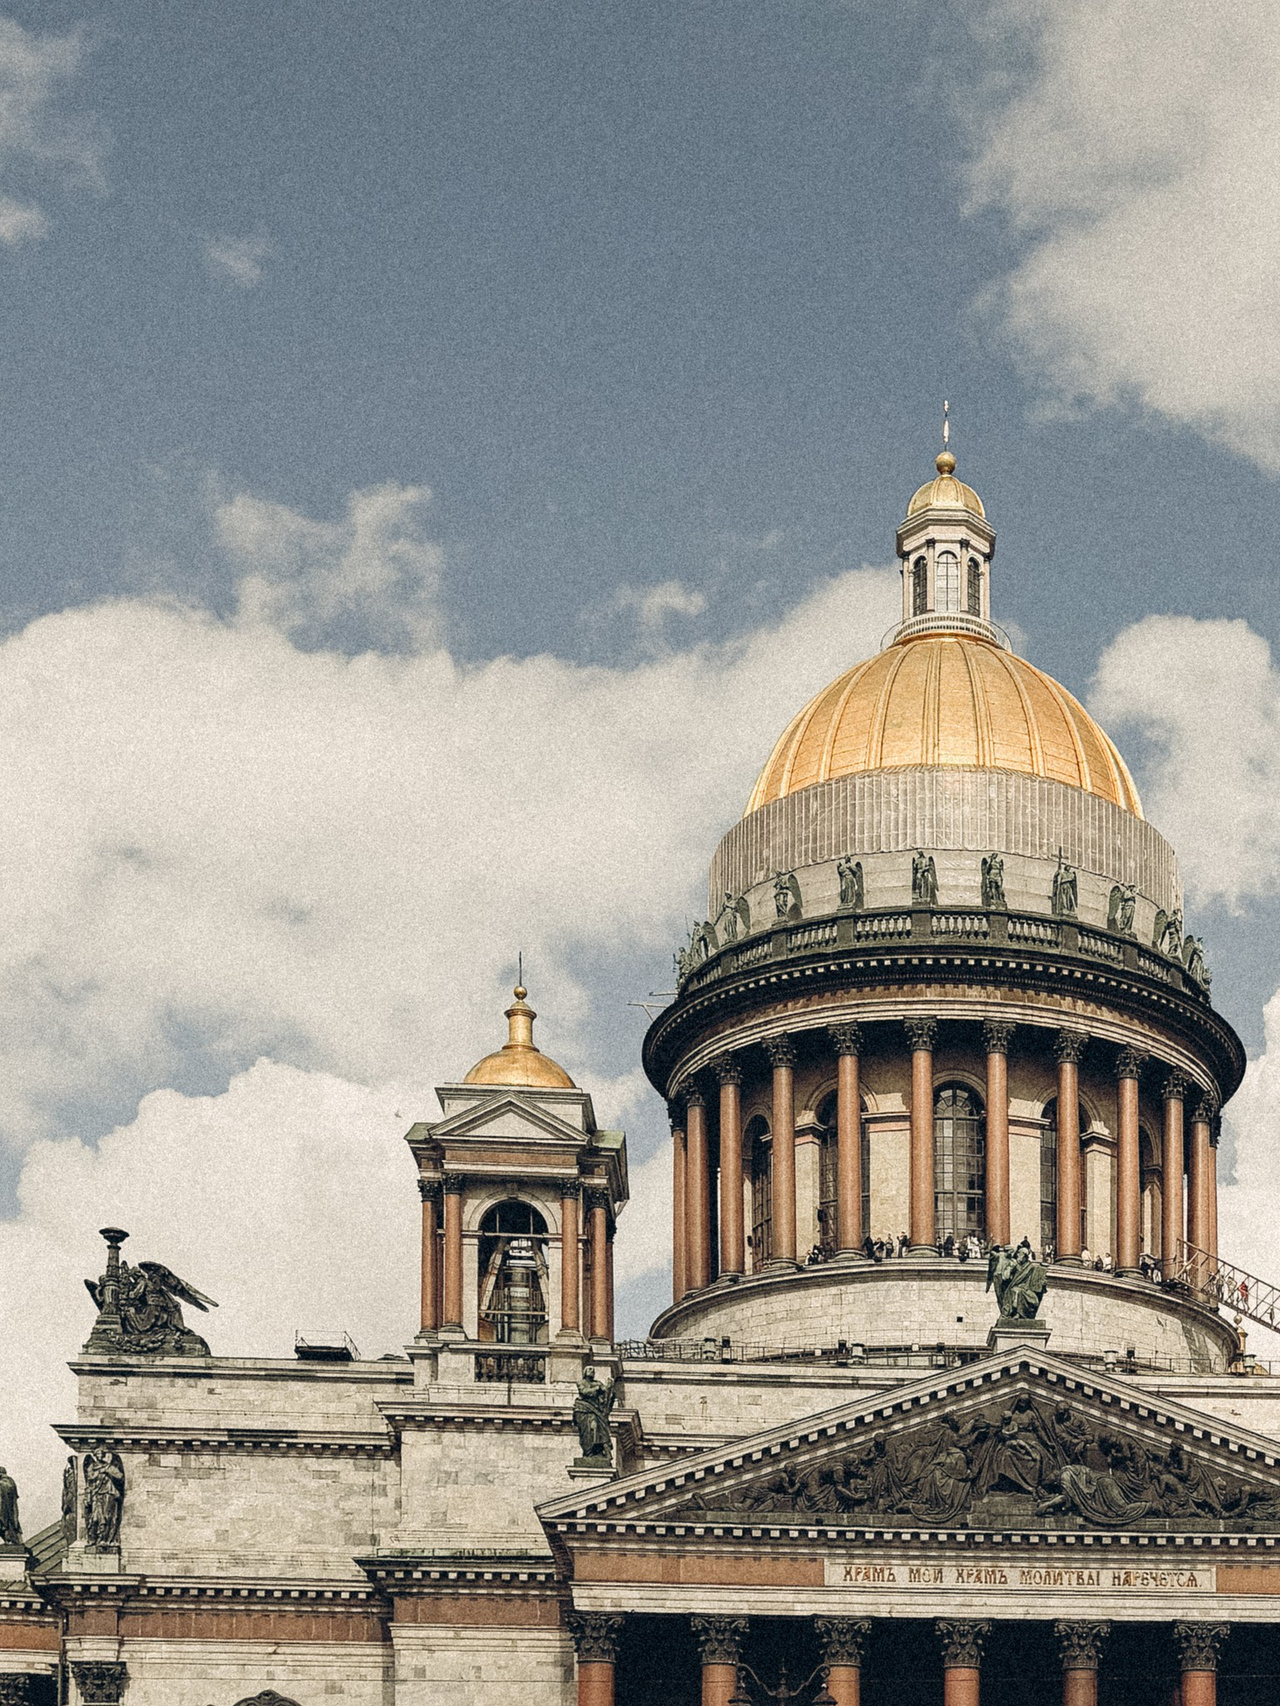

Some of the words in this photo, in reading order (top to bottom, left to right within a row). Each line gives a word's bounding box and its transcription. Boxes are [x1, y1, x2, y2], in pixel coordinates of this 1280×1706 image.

[843, 1566, 896, 1583] ХРАМЪ
[955, 1567, 1008, 1584] ХРАМЪ
[1020, 1570, 1100, 1585] МОЛИТВЫ
